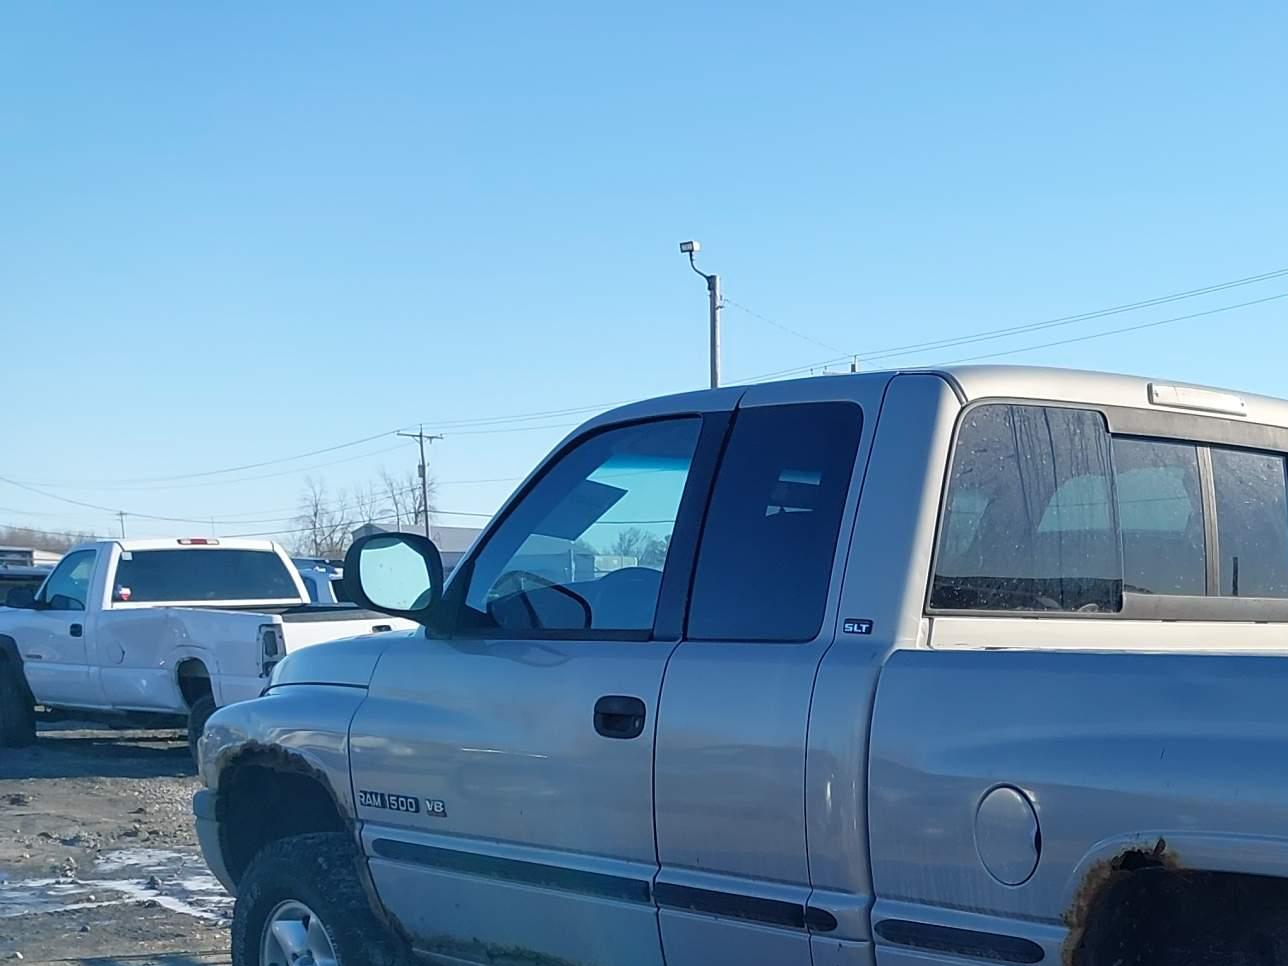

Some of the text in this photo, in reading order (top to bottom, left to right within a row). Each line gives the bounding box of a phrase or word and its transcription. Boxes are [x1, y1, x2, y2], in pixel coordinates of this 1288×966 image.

[844, 623, 870, 633] SLT
[358, 791, 382, 807] RAM
[385, 795, 416, 812] 1500
